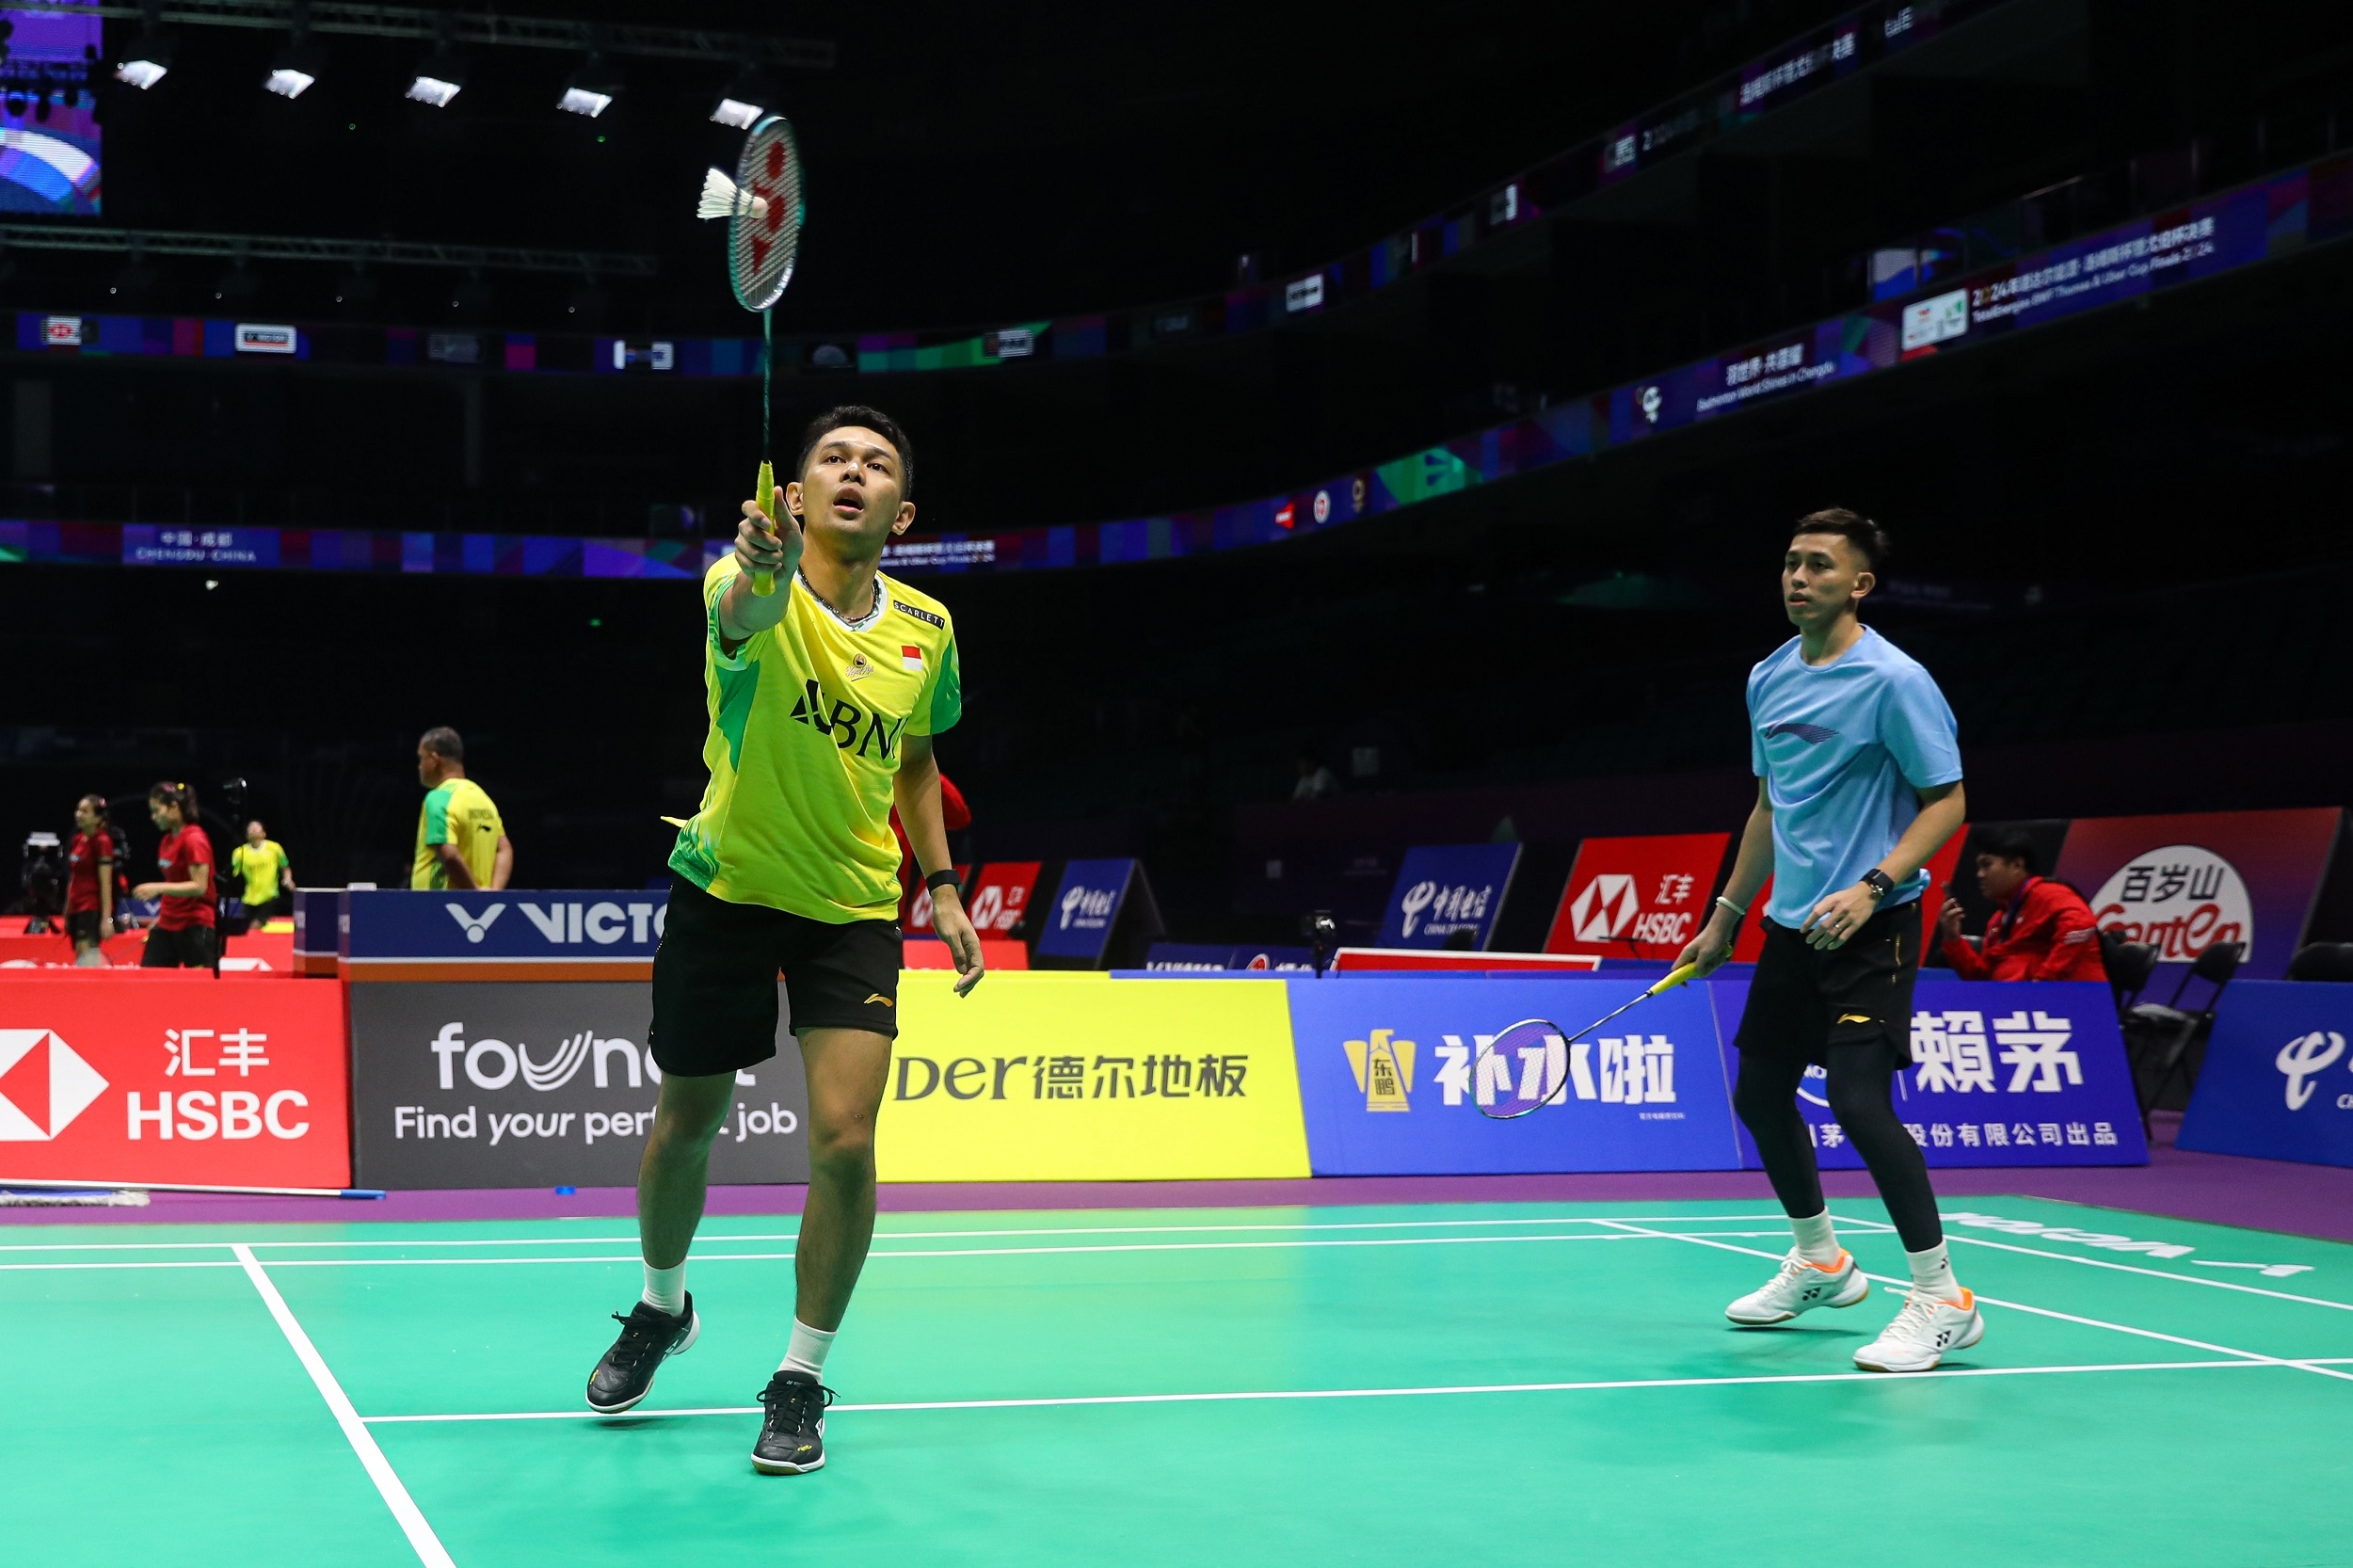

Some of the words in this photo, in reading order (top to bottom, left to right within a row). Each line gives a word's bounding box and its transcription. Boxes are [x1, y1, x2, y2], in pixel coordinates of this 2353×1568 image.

[893, 601, 945, 627] SCARLETT
[1655, 872, 1694, 904] 汇丰
[2120, 864, 2224, 904] 百岁山
[518, 902, 667, 944] VICT
[1632, 912, 1692, 945] HSBC
[163, 1028, 270, 1078] 汇丰
[1433, 1034, 1677, 1106] 补水啦
[892, 1055, 1028, 1101] Der
[1032, 1055, 1248, 1100] 德尔地板
[127, 1089, 310, 1141] HSBC
[395, 1106, 477, 1139] Find
[488, 1112, 576, 1146] your
[736, 1102, 798, 1143] job
